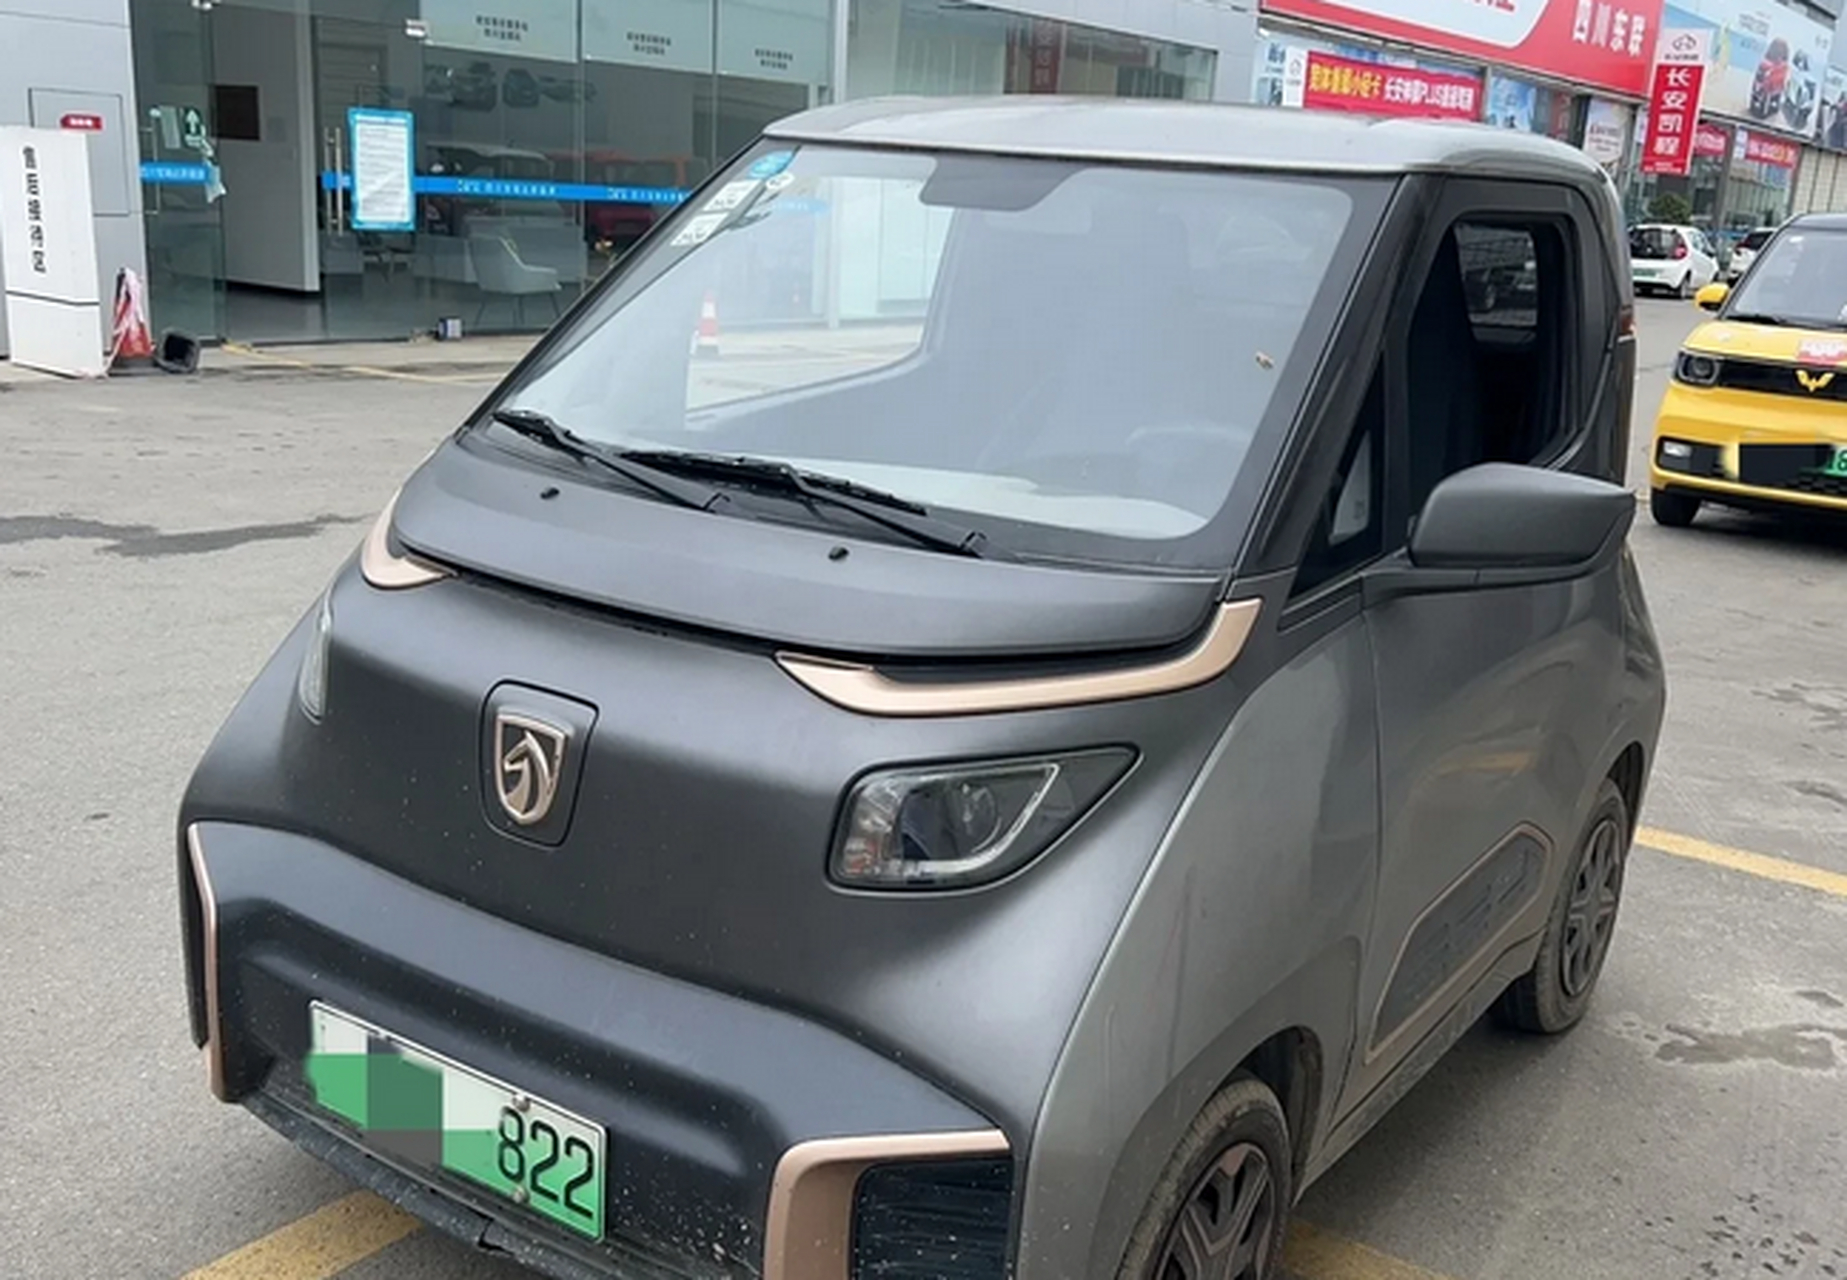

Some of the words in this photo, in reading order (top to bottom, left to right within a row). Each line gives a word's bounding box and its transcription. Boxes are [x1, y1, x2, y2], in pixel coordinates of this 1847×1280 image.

[1653, 67, 1692, 156] 长安凯程
[498, 1105, 595, 1220] 822
